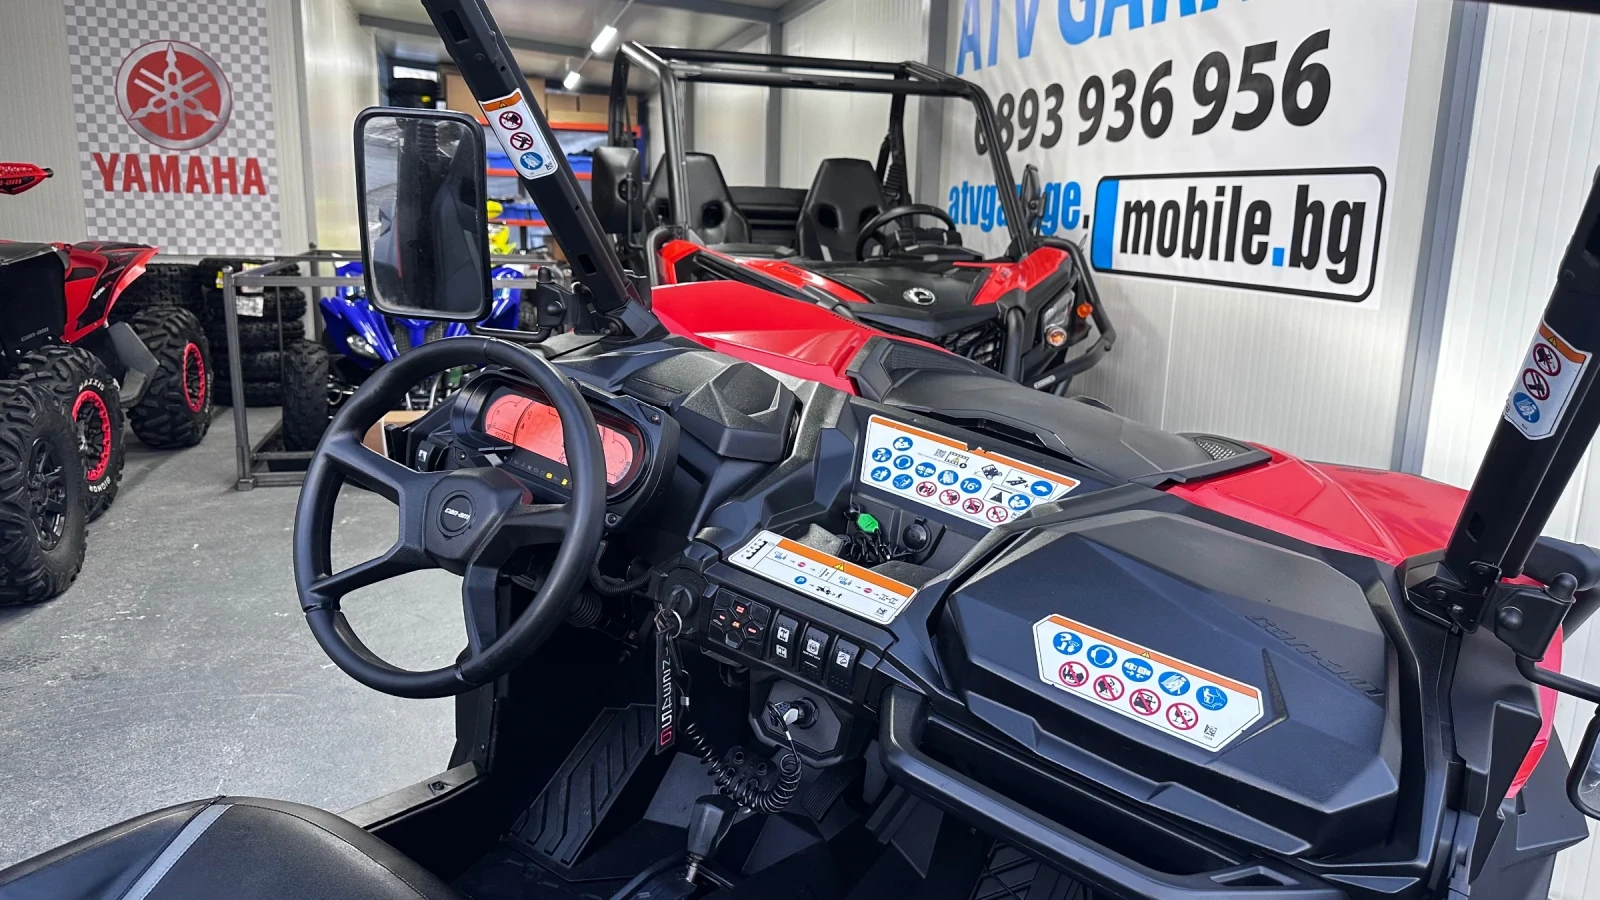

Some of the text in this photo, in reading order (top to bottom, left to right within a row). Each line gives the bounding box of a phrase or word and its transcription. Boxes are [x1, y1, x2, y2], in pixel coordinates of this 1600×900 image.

[1078, 60, 1174, 146] 936
[1192, 28, 1332, 136] 956
[93, 153, 267, 195] YAMAHA
[1119, 184, 1367, 284] mobile.bg
[963, 480, 980, 491] 16+
[444, 507, 470, 520] can-am
